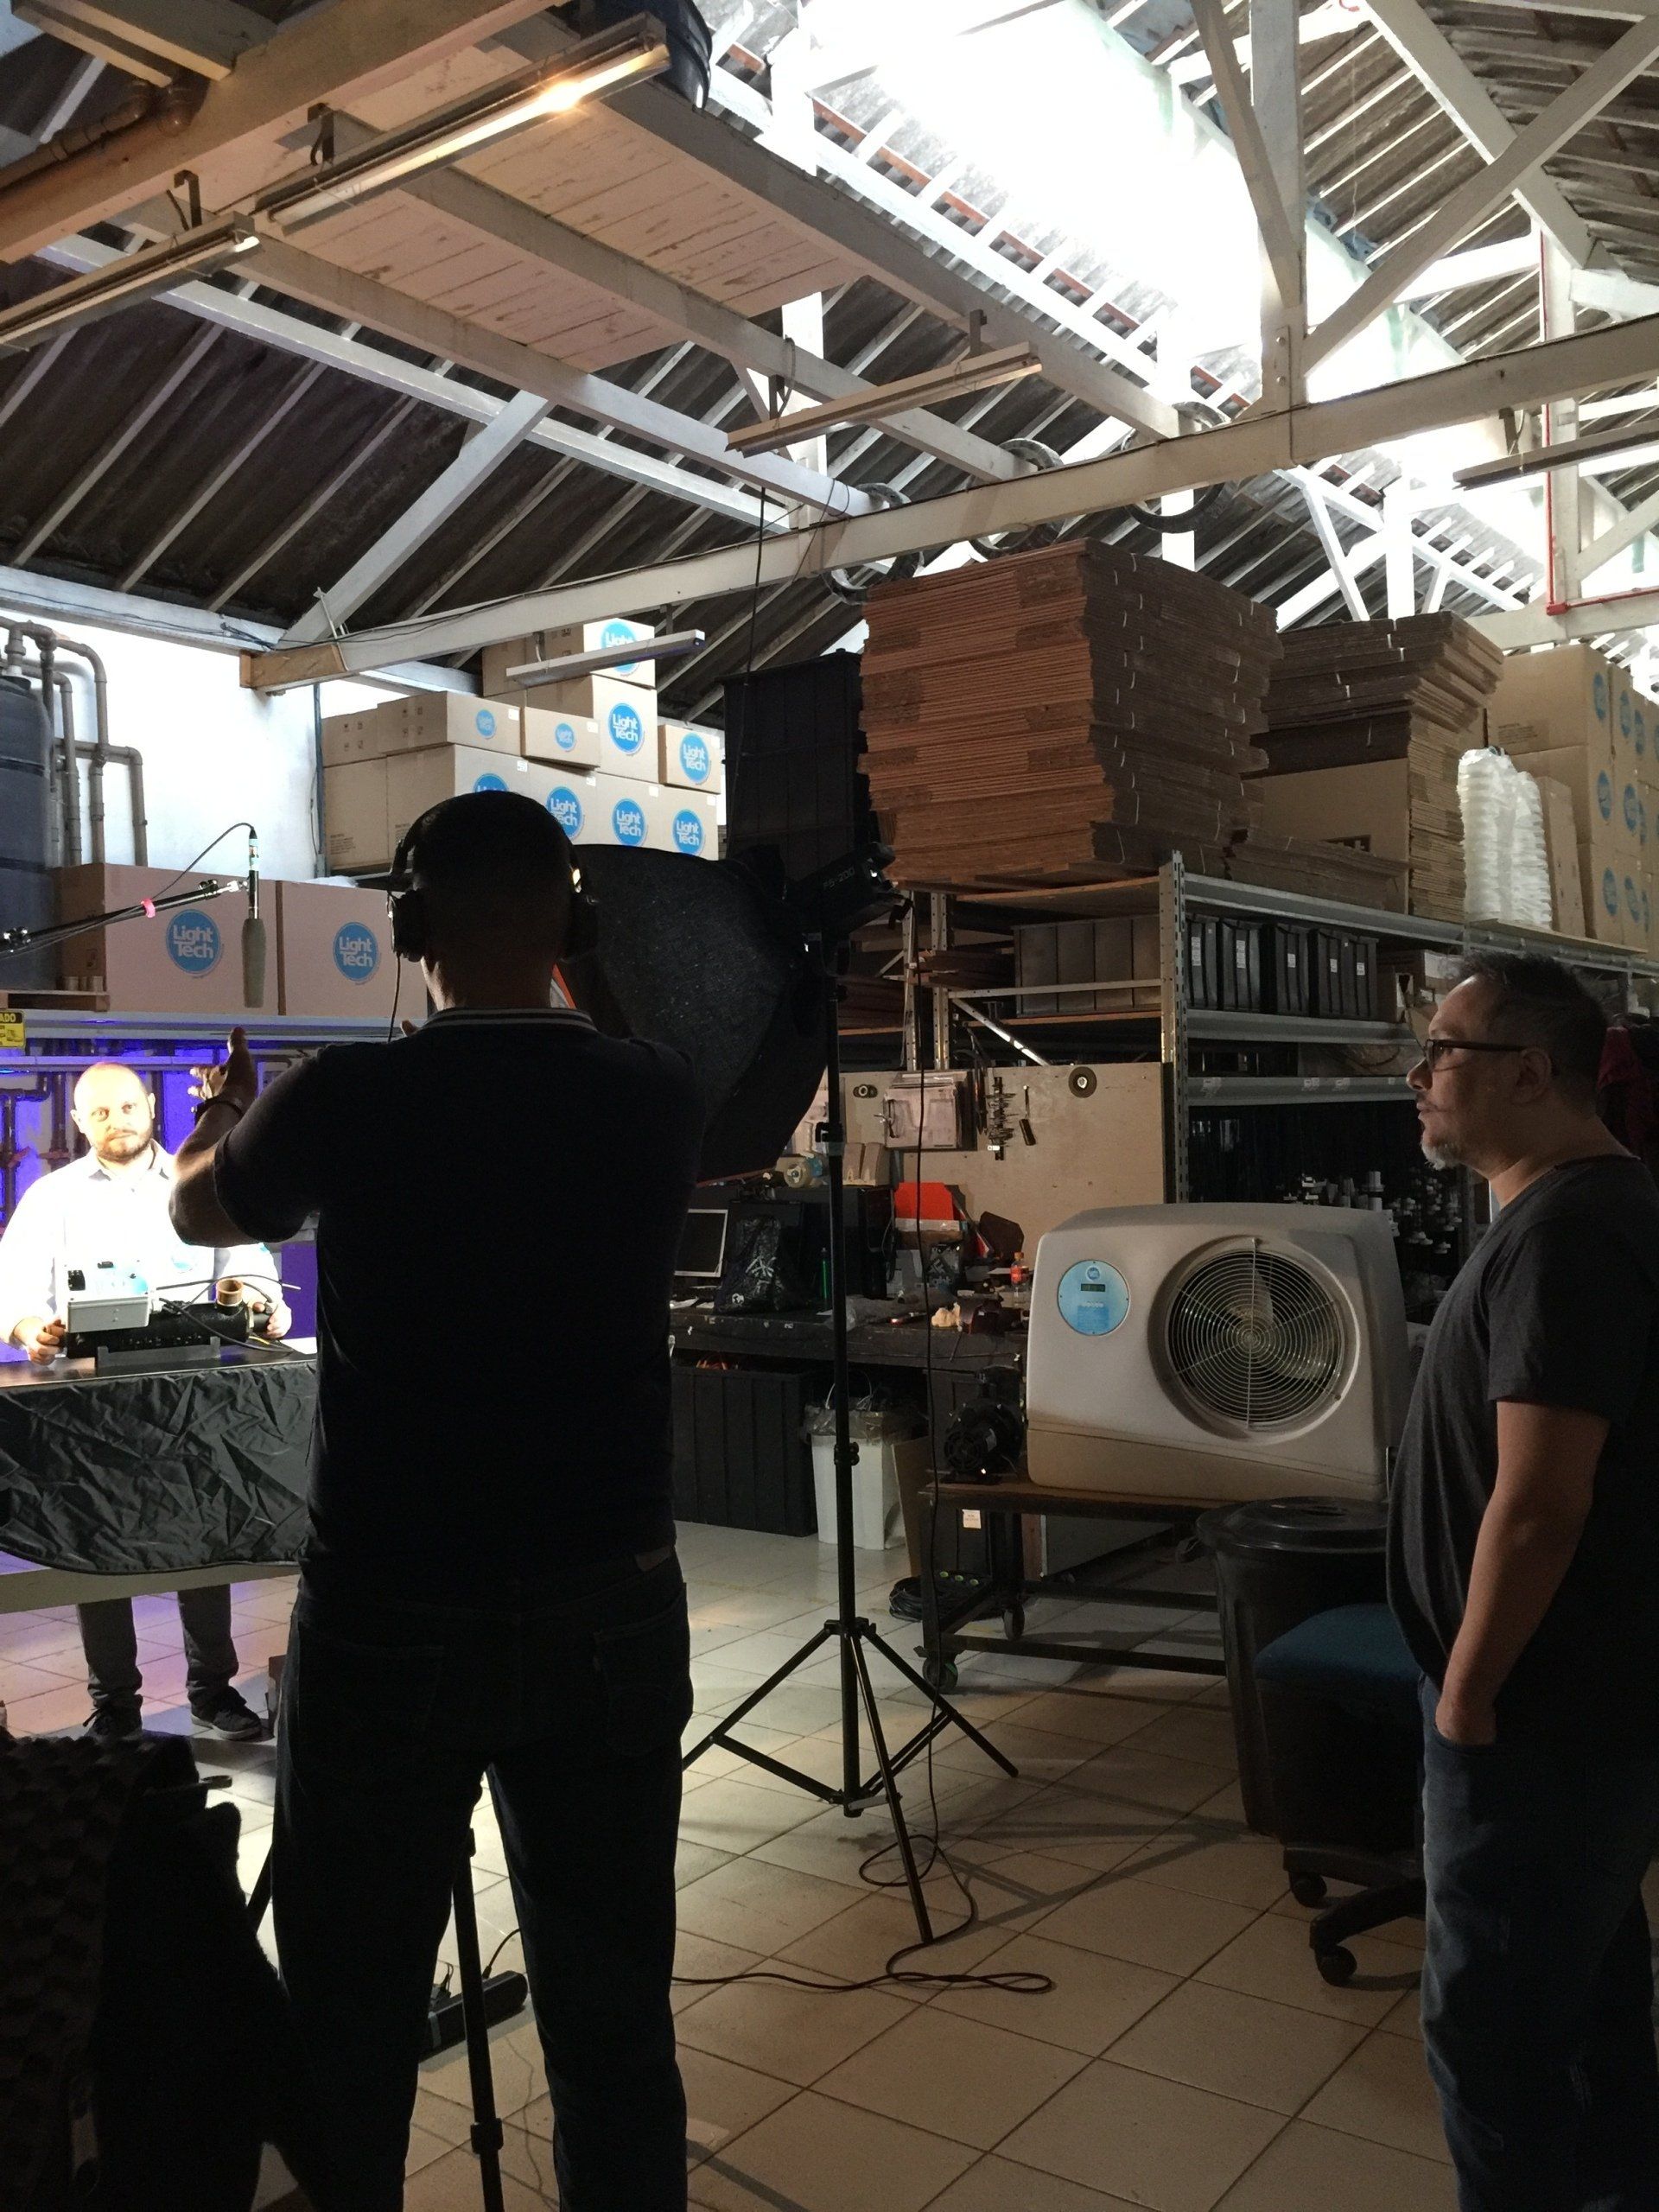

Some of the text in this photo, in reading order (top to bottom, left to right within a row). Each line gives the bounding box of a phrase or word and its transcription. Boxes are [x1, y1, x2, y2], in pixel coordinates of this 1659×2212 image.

[612, 713, 638, 732] Light
[613, 726, 639, 742] Tech
[683, 743, 705, 760] Light
[683, 756, 706, 771] Tech
[550, 798, 577, 815] Light
[616, 810, 641, 828] Light
[618, 823, 642, 837] Tech
[677, 820, 699, 836] Light
[677, 832, 700, 846] Tech
[173, 925, 213, 945] Light
[174, 941, 214, 958] Tech
[339, 937, 372, 955] Light
[340, 951, 373, 968] Tech
